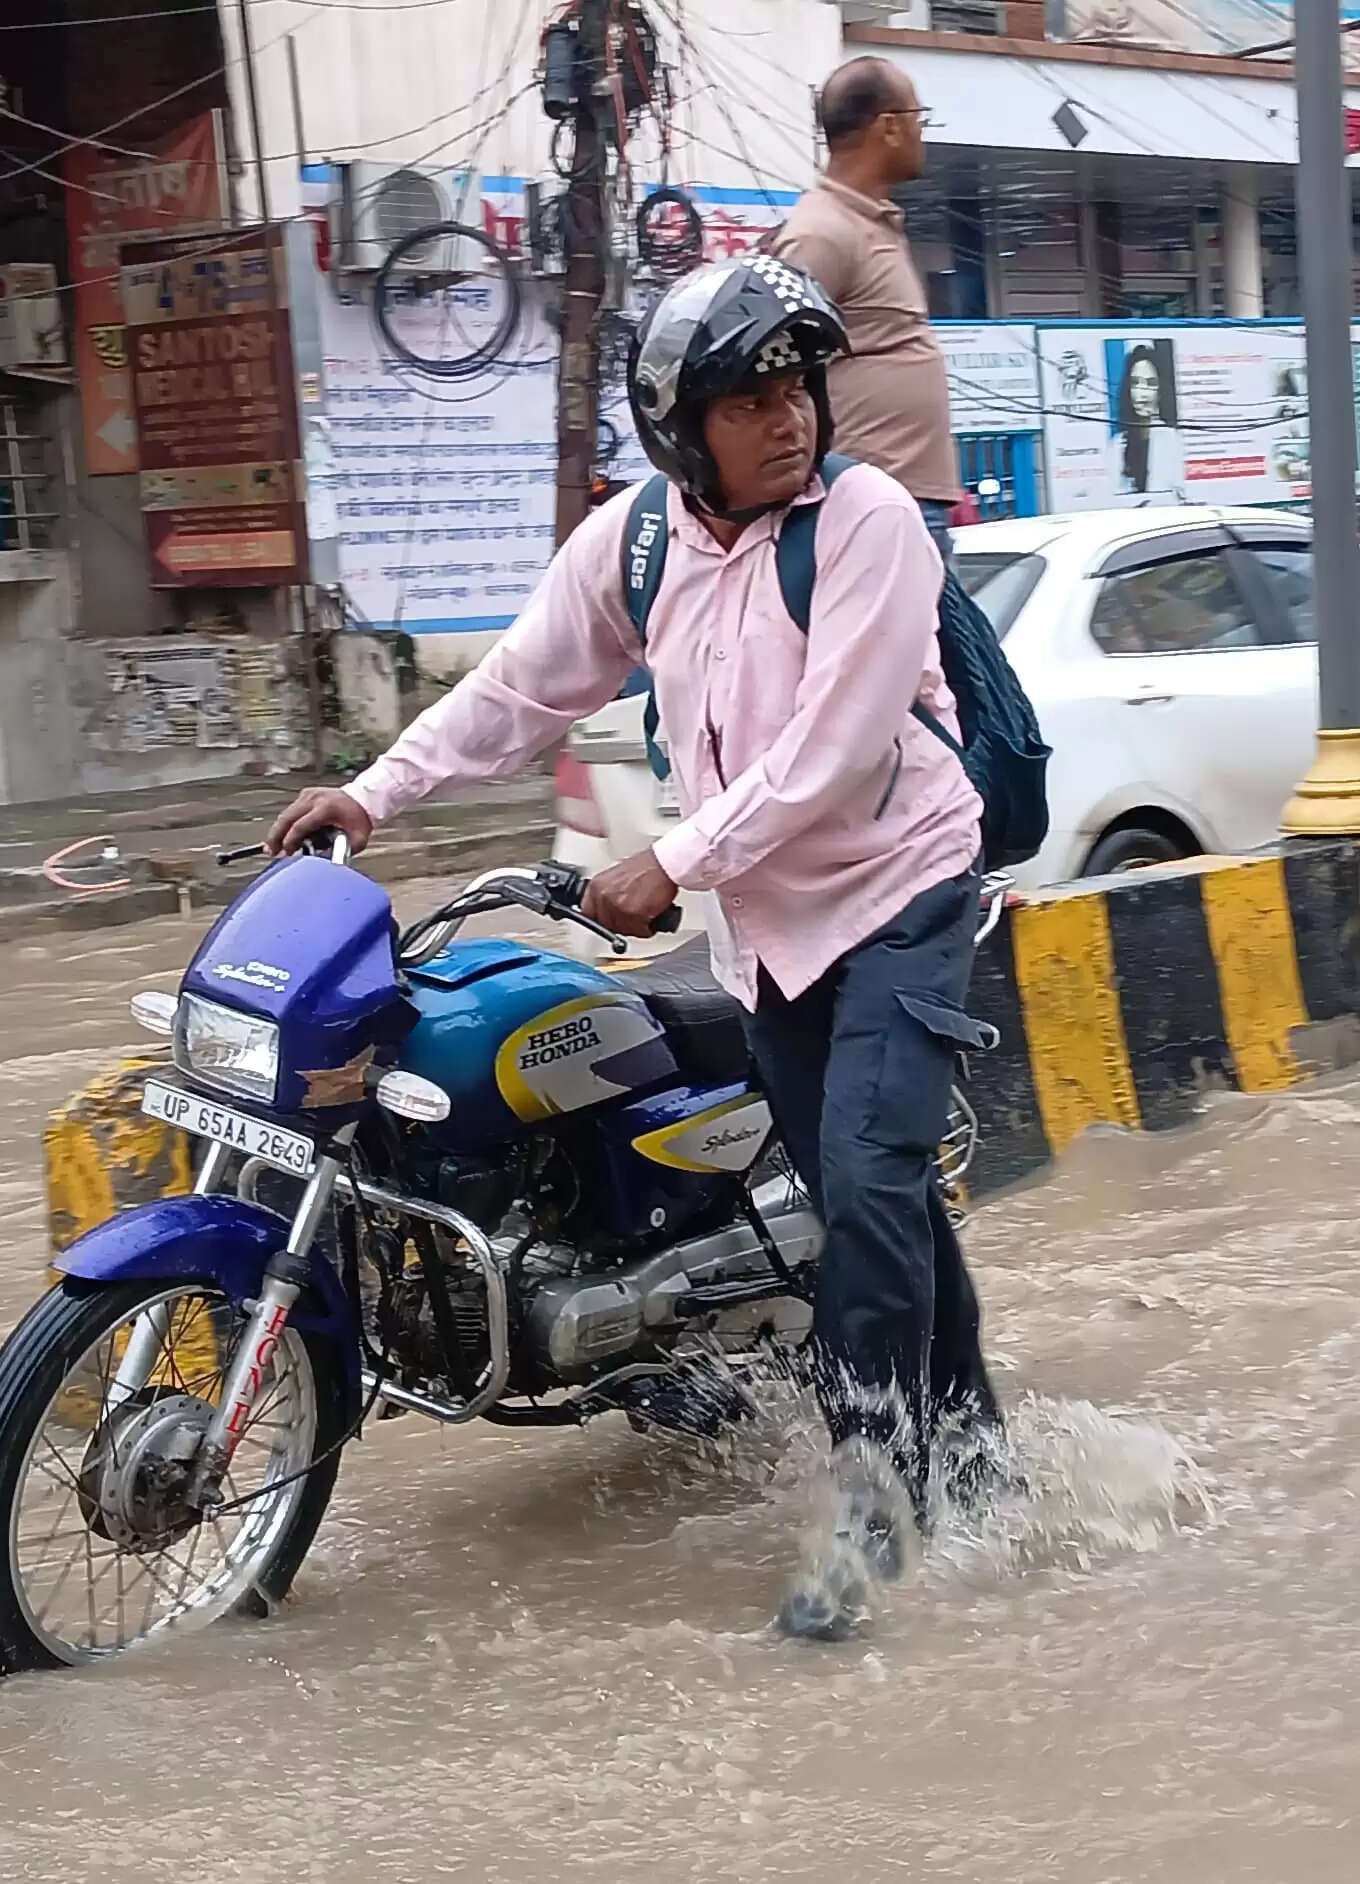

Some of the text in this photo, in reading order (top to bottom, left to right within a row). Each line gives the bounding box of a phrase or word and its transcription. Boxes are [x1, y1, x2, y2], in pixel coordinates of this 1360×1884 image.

[630, 511, 664, 591] safari
[518, 1031, 603, 1070] HONDA
[526, 1015, 592, 1051] HERO
[162, 1093, 306, 1169] UP 65AA 2649
